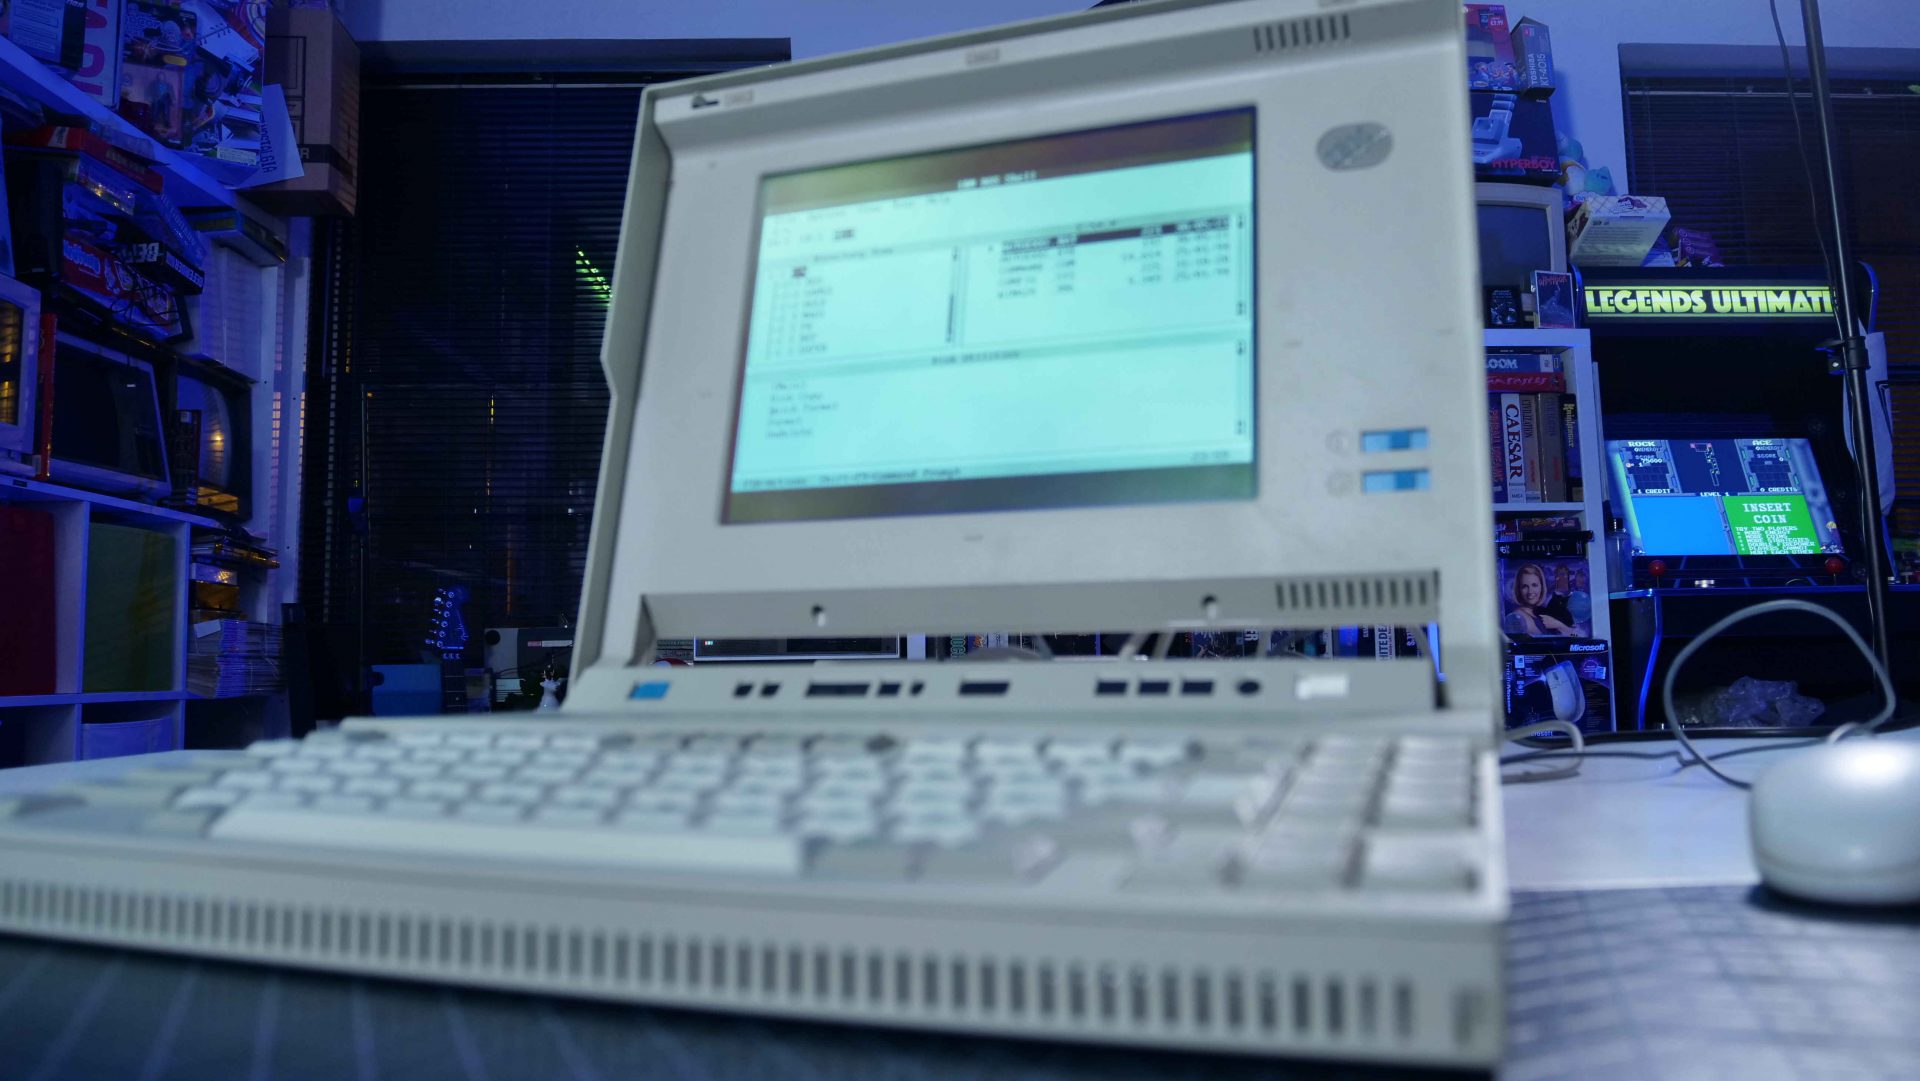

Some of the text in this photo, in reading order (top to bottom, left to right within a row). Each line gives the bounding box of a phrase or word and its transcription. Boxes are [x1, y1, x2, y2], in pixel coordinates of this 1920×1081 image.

[1527, 53, 1538, 86] TOSHIBA
[1491, 158, 1556, 170] HYPERBOY
[1585, 289, 1707, 314] LEGENDS
[1505, 403, 1523, 480] CAESAR
[1742, 502, 1791, 512] INSERT
[1753, 514, 1787, 524] COIN
[1569, 643, 1605, 652] Microsoft
